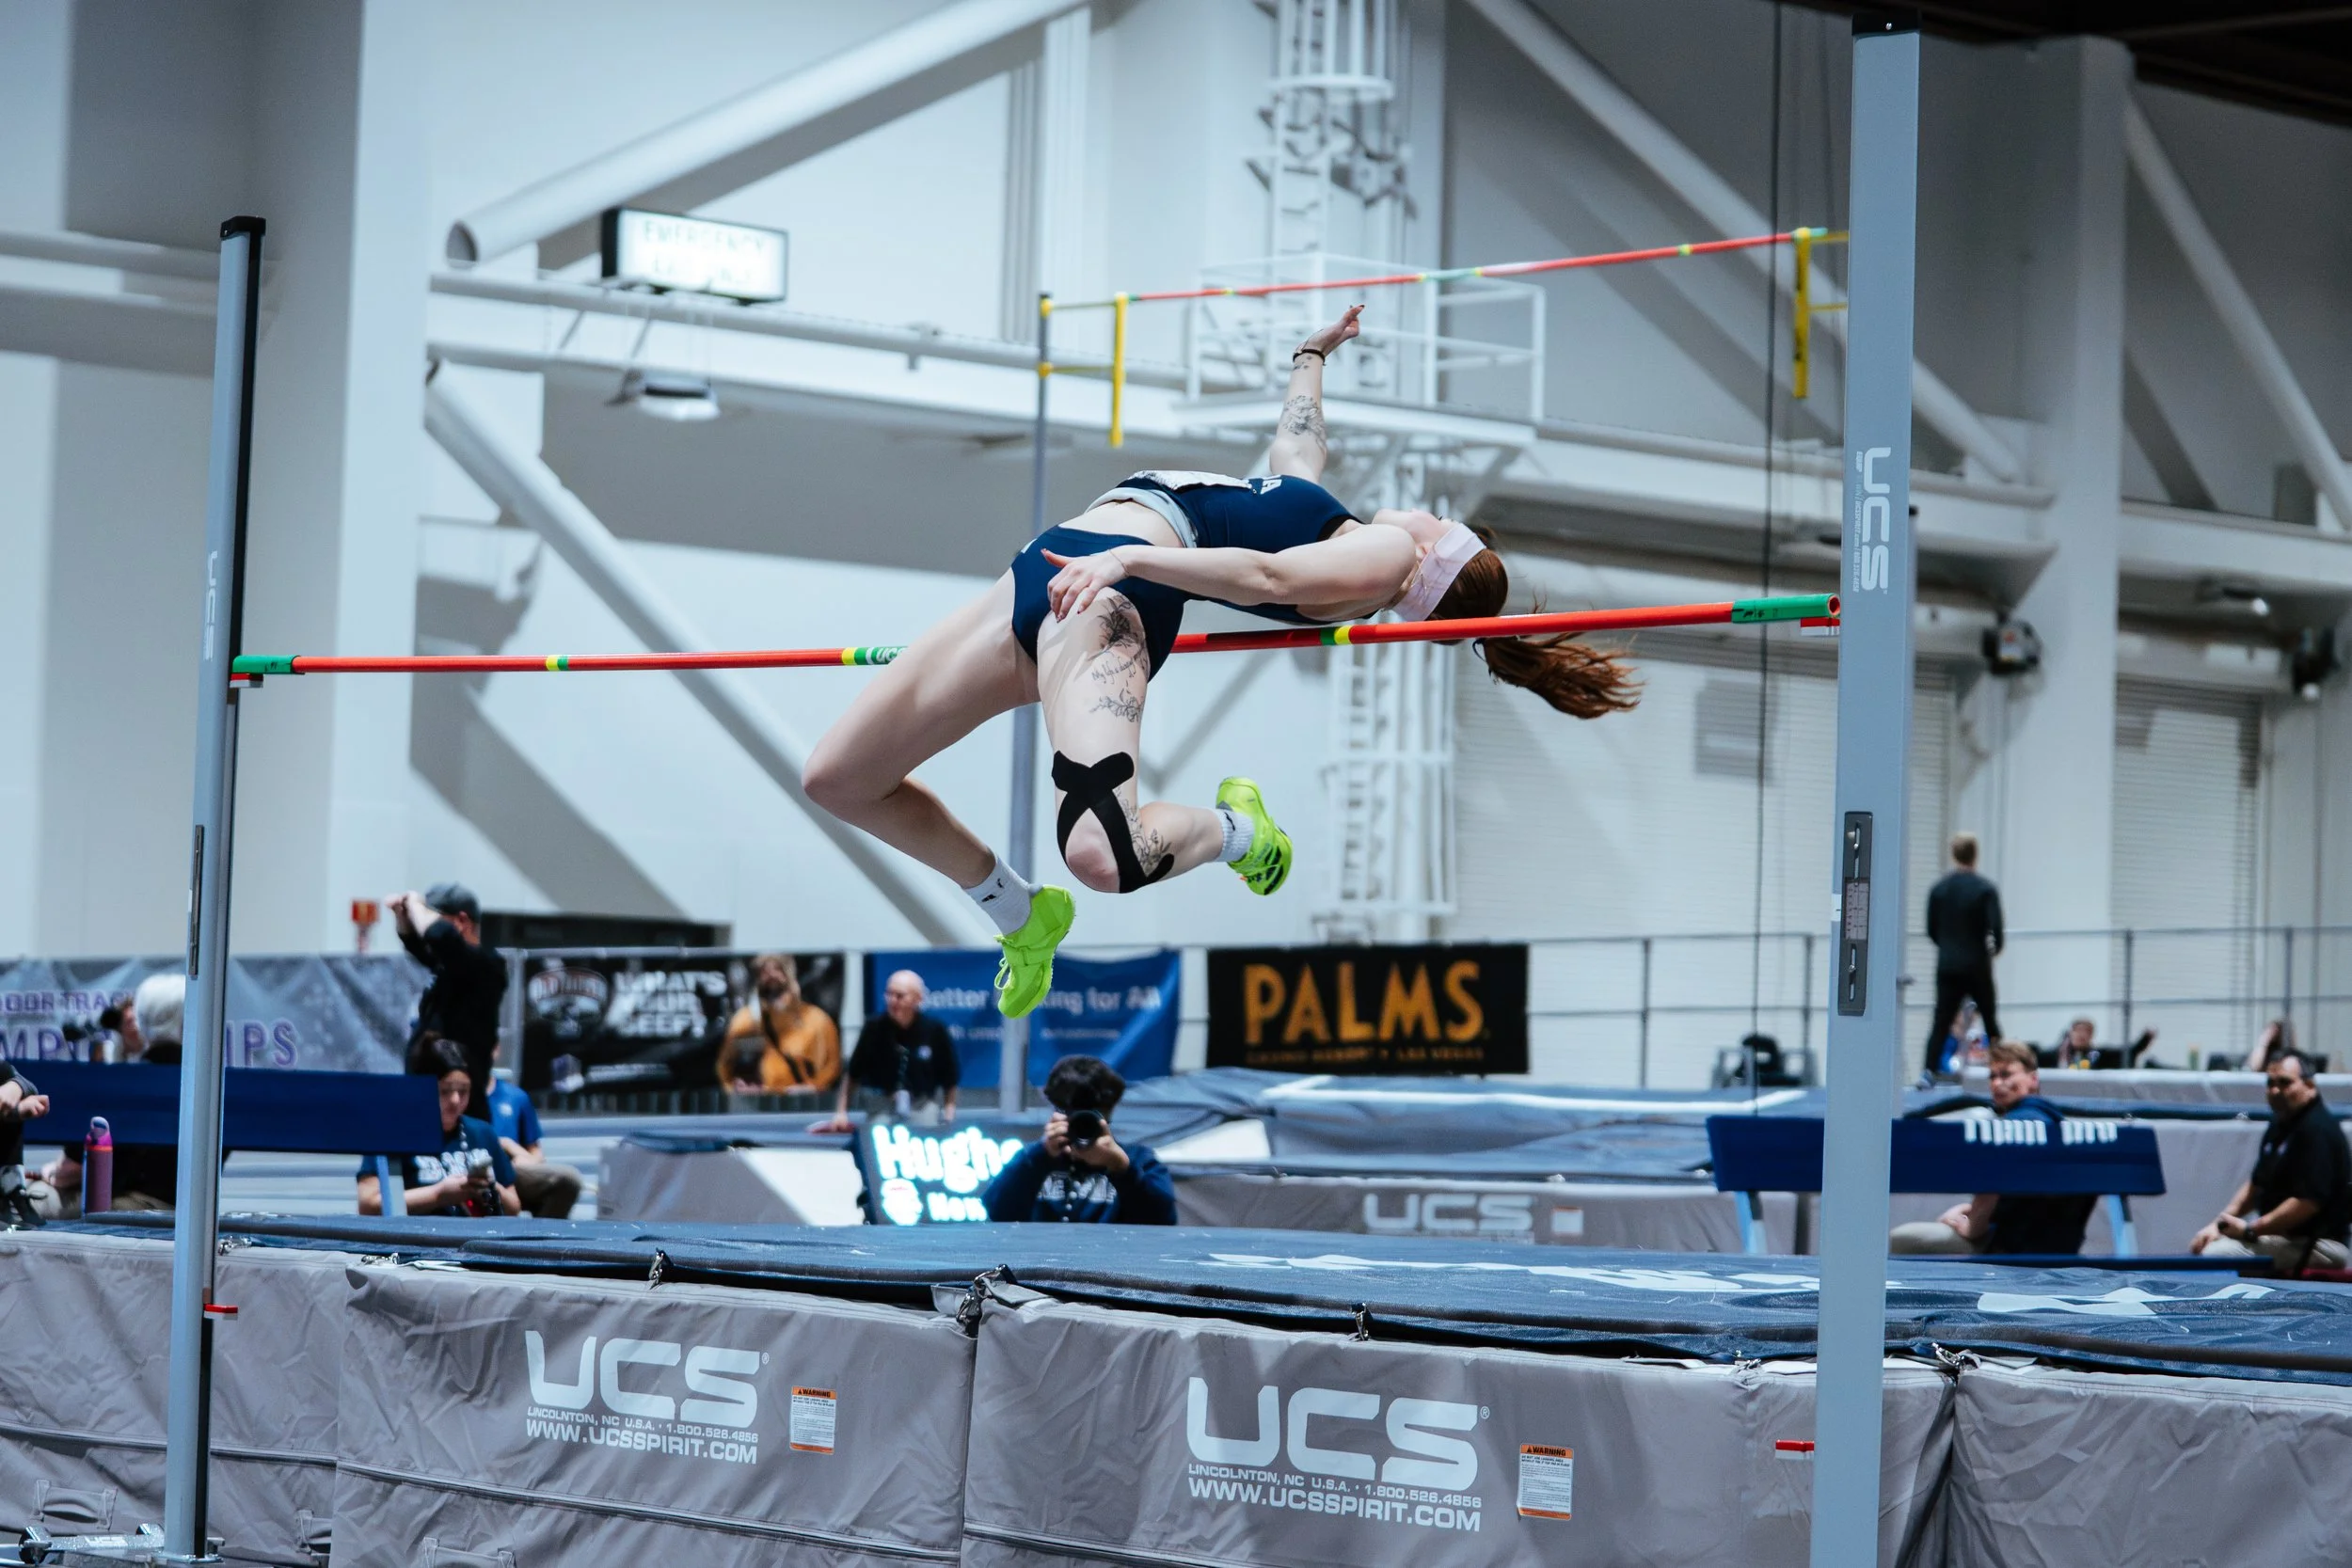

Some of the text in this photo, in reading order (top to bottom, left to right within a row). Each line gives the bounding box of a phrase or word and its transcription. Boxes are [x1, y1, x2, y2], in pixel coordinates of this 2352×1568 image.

[1861, 447, 1892, 591] UCS
[1244, 959, 1485, 1046] PALMS
[1364, 1193, 1534, 1231] UCS
[525, 1330, 760, 1428] UCS
[526, 1418, 758, 1465] WWW.UCSSPIRIT.COM
[527, 1406, 598, 1426] LINCOLNTON,
[602, 1417, 620, 1427] NC
[625, 1418, 655, 1431] U.S.A.
[1186, 1376, 1478, 1492] UCS
[1533, 1446, 1566, 1456] WARNING
[1188, 1463, 1483, 1509] LINCOLNTON, NC U.S.A. 1.800.526.4856
[1188, 1477, 1482, 1532] WWW.UCSSPIRIT.COM
